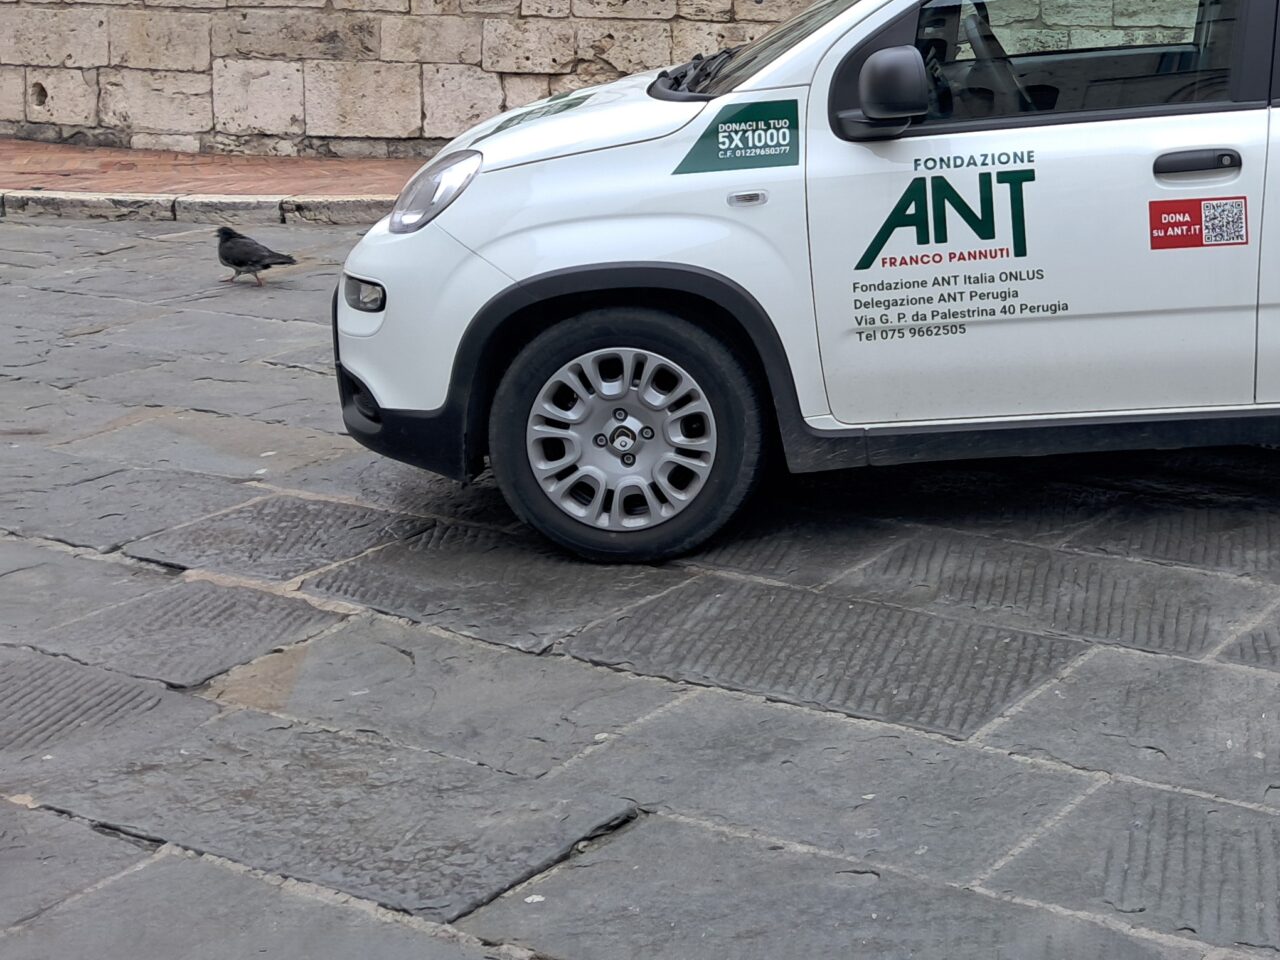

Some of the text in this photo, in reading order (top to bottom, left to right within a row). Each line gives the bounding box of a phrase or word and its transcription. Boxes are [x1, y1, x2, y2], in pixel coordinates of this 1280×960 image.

[718, 119, 789, 132] DONACI IL TUO
[718, 128, 790, 149] 5X1000
[718, 146, 790, 158] C.F. 01229650377
[914, 150, 1035, 171] FONDAZIONE
[854, 168, 1036, 270] ANT
[1161, 213, 1191, 223] DONA
[1152, 225, 1200, 237] su ANT.IT
[881, 247, 1010, 268] FRANCO PANNUTI
[852, 269, 1045, 293] Fondazione ANT Italia ONLUS
[854, 288, 1019, 311] Delegazione ANT Perugia
[855, 300, 1069, 326] Via G. P. da Palestrina 40 Perugia
[856, 324, 966, 342] Tel 075 9662505
